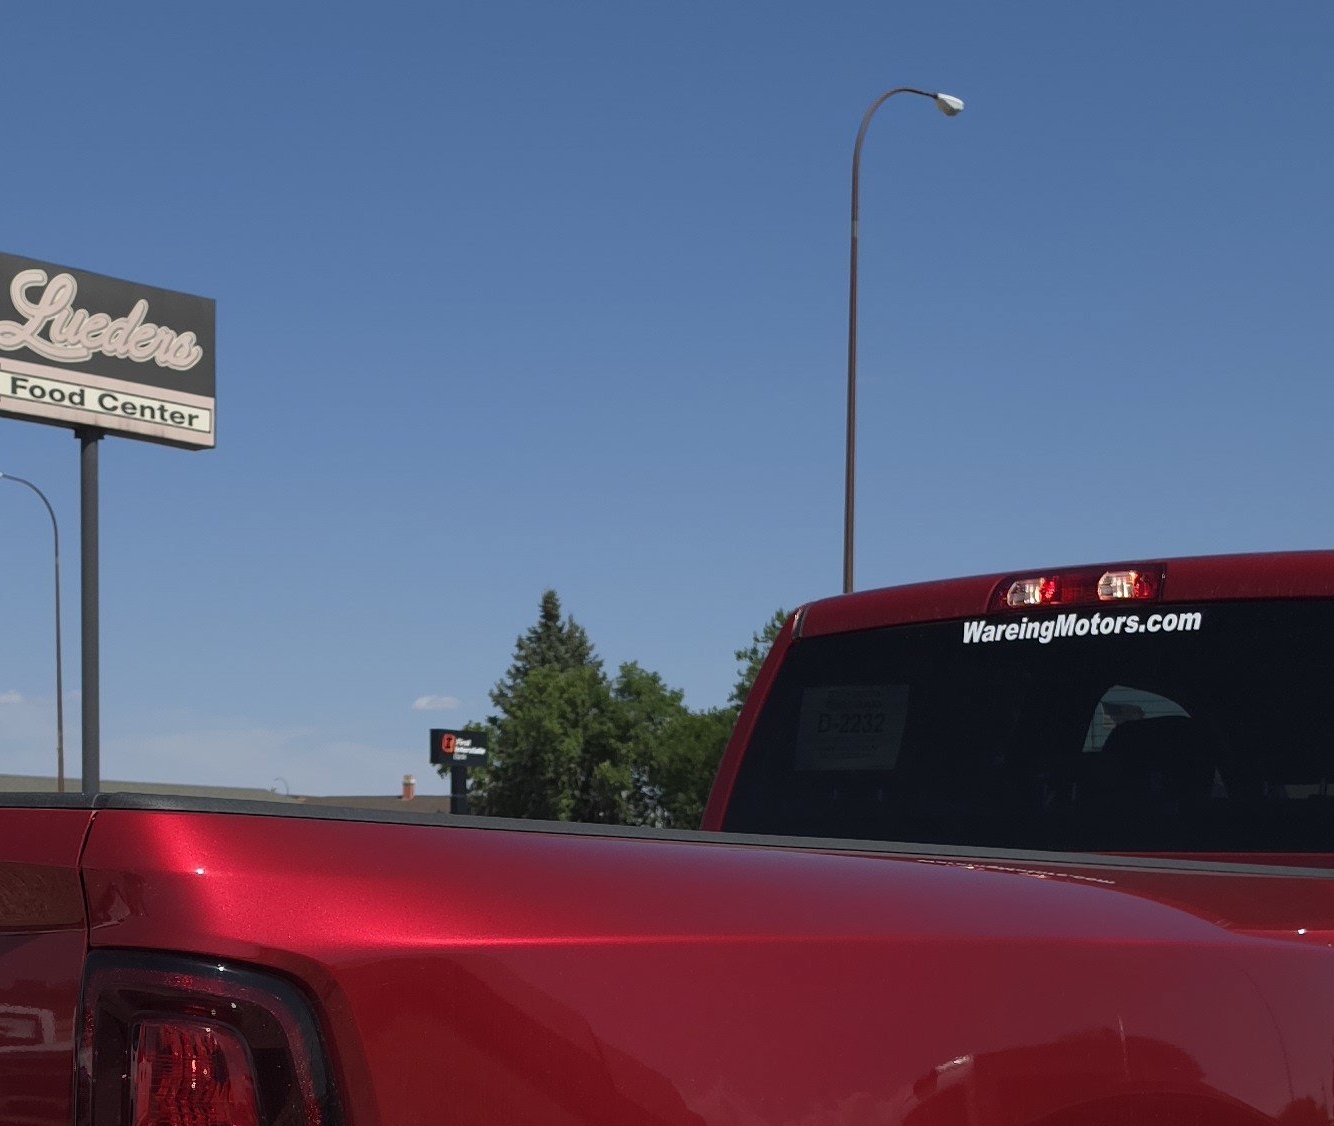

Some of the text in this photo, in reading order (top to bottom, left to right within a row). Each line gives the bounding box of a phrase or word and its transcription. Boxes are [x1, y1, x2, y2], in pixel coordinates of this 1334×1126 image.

[9, 375, 200, 427] Food Center
[962, 611, 1202, 644] WareingMotors.com
